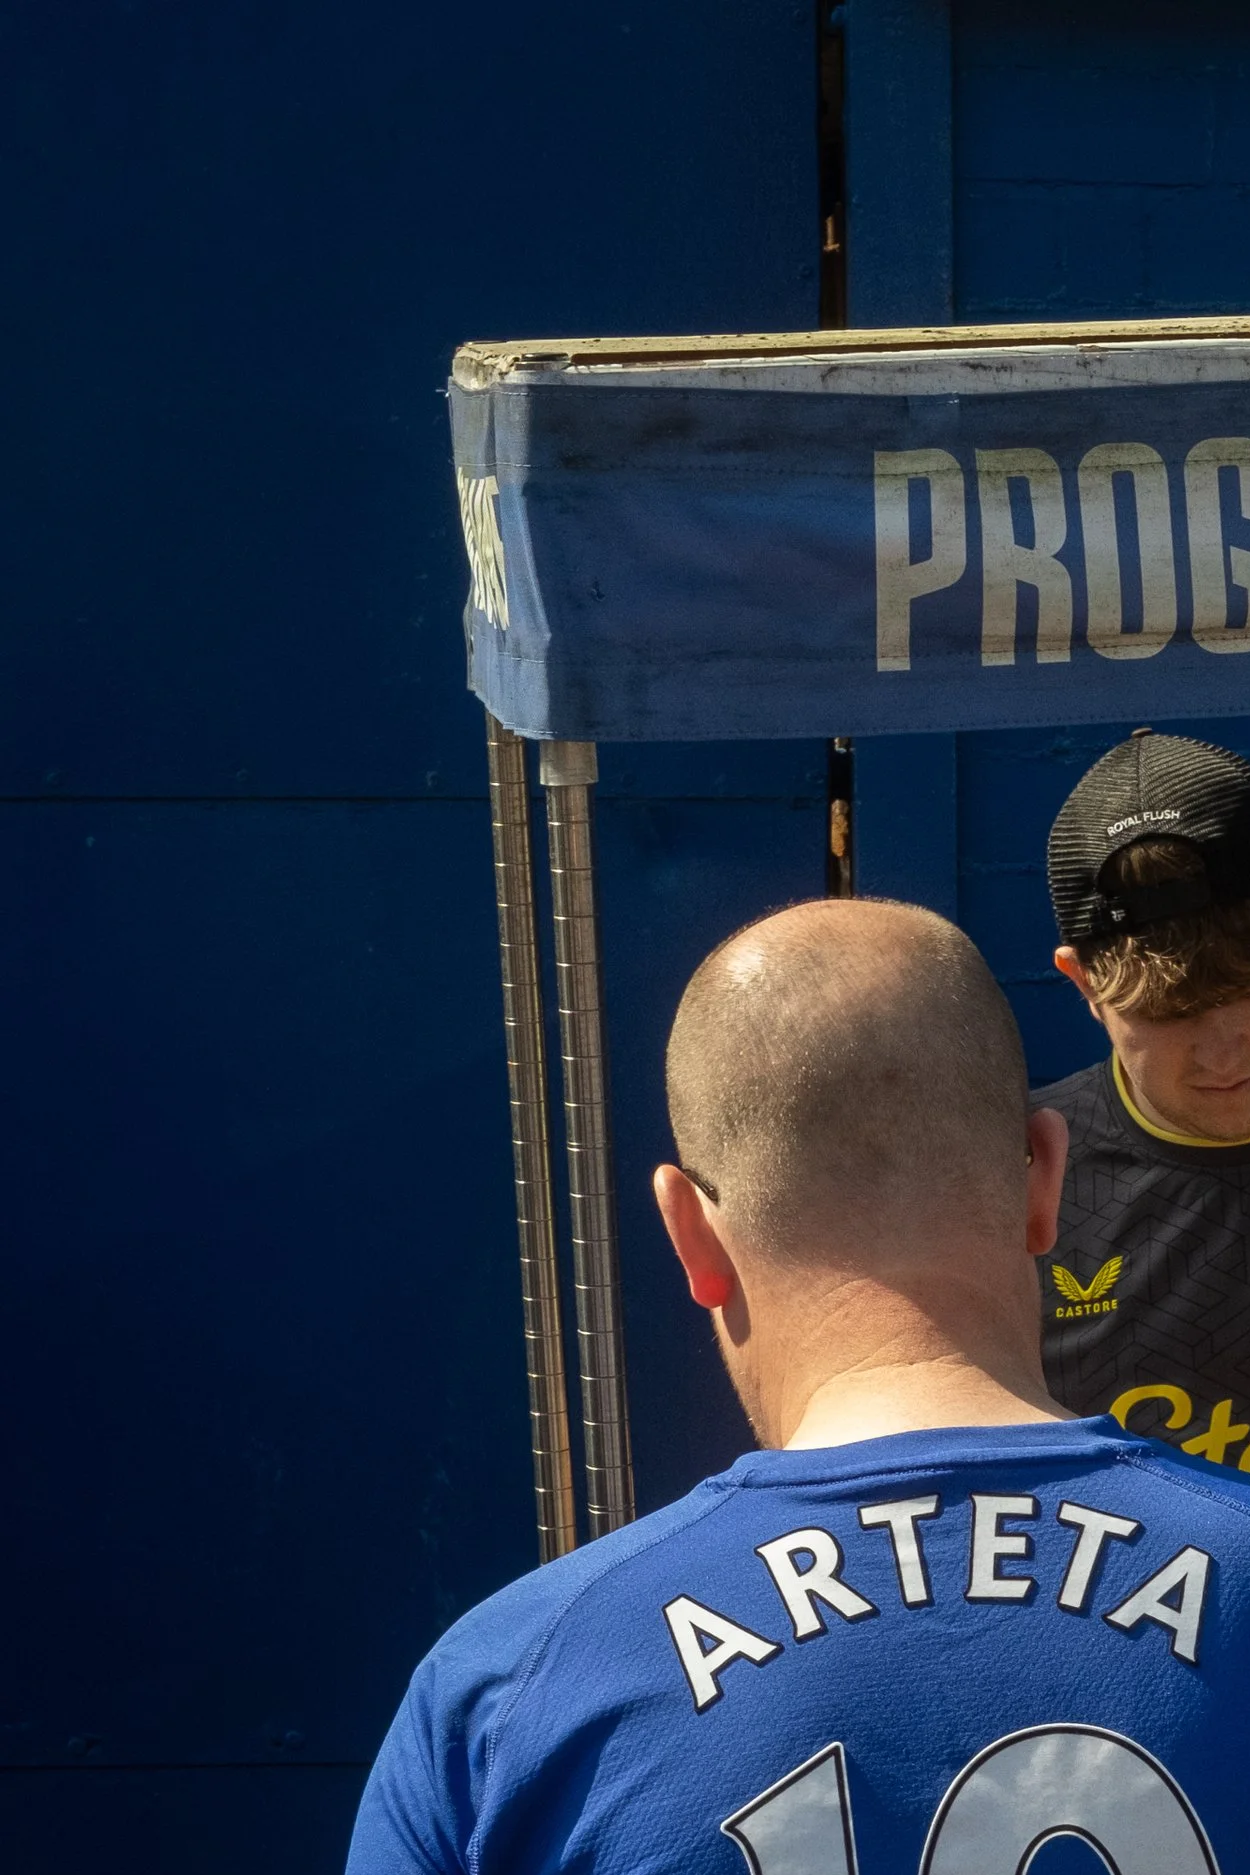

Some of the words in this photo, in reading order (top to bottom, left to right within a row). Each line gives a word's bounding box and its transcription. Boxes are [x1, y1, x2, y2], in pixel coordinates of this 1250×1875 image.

[1106, 815, 1142, 837] ROYAL
[1143, 809, 1180, 822] FLUSH
[1055, 1297, 1118, 1319] CASTORE
[662, 1492, 1217, 1712] ARTETA
